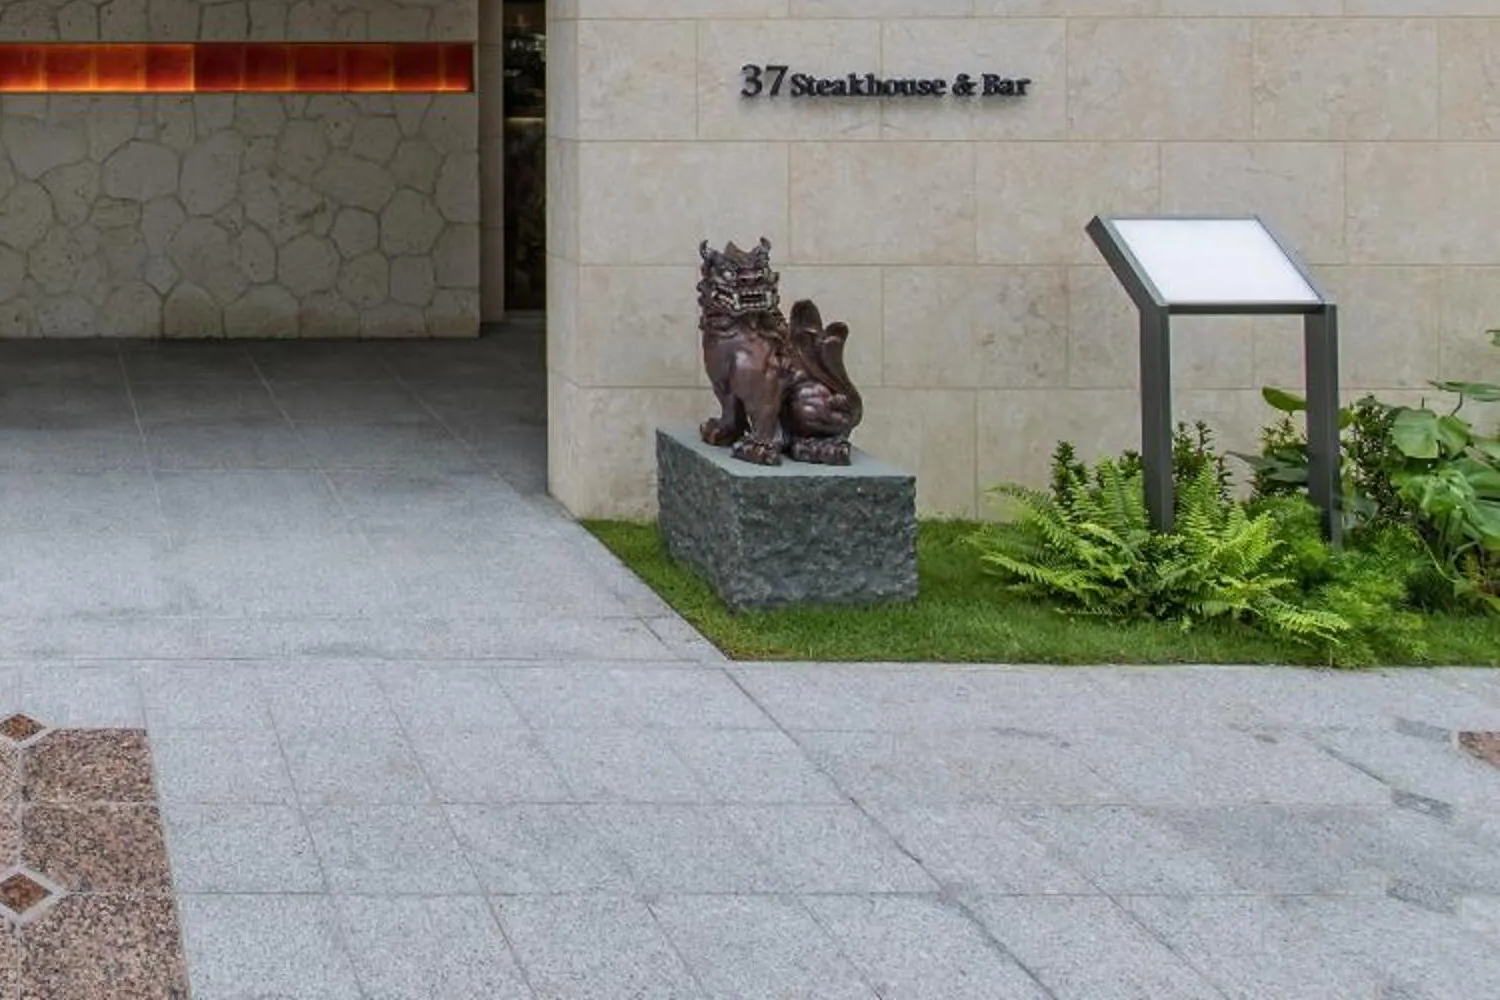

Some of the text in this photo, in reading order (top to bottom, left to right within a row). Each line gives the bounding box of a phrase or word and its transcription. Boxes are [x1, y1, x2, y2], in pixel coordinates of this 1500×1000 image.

[740, 64, 1031, 98] 37 Steakhouse & Bar
